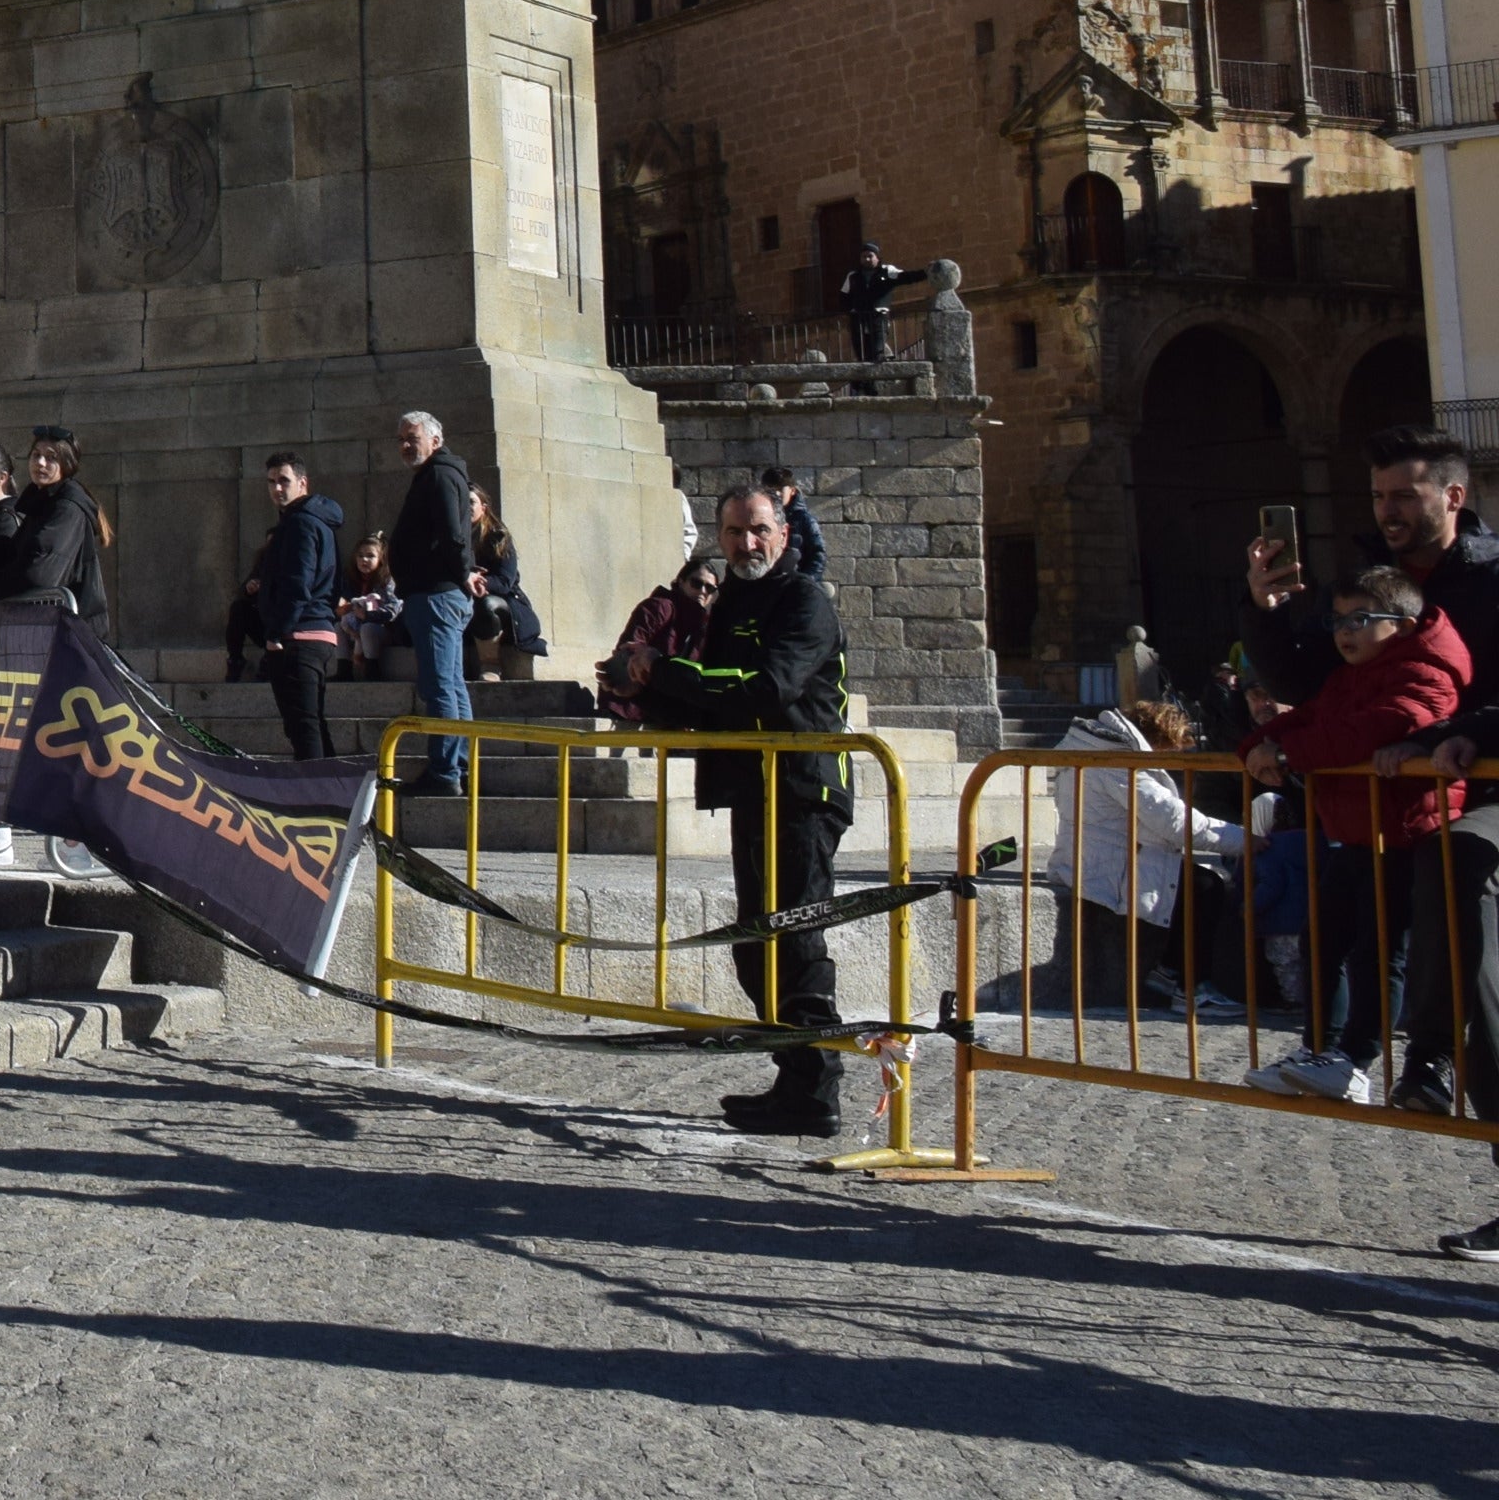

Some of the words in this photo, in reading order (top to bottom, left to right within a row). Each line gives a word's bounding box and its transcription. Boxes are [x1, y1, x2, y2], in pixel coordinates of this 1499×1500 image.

[502, 107, 550, 137] FRANCISCO
[506, 138, 548, 165] PIZARRO
[511, 215, 527, 233] DEL
[769, 901, 832, 928] #DEPORTE
